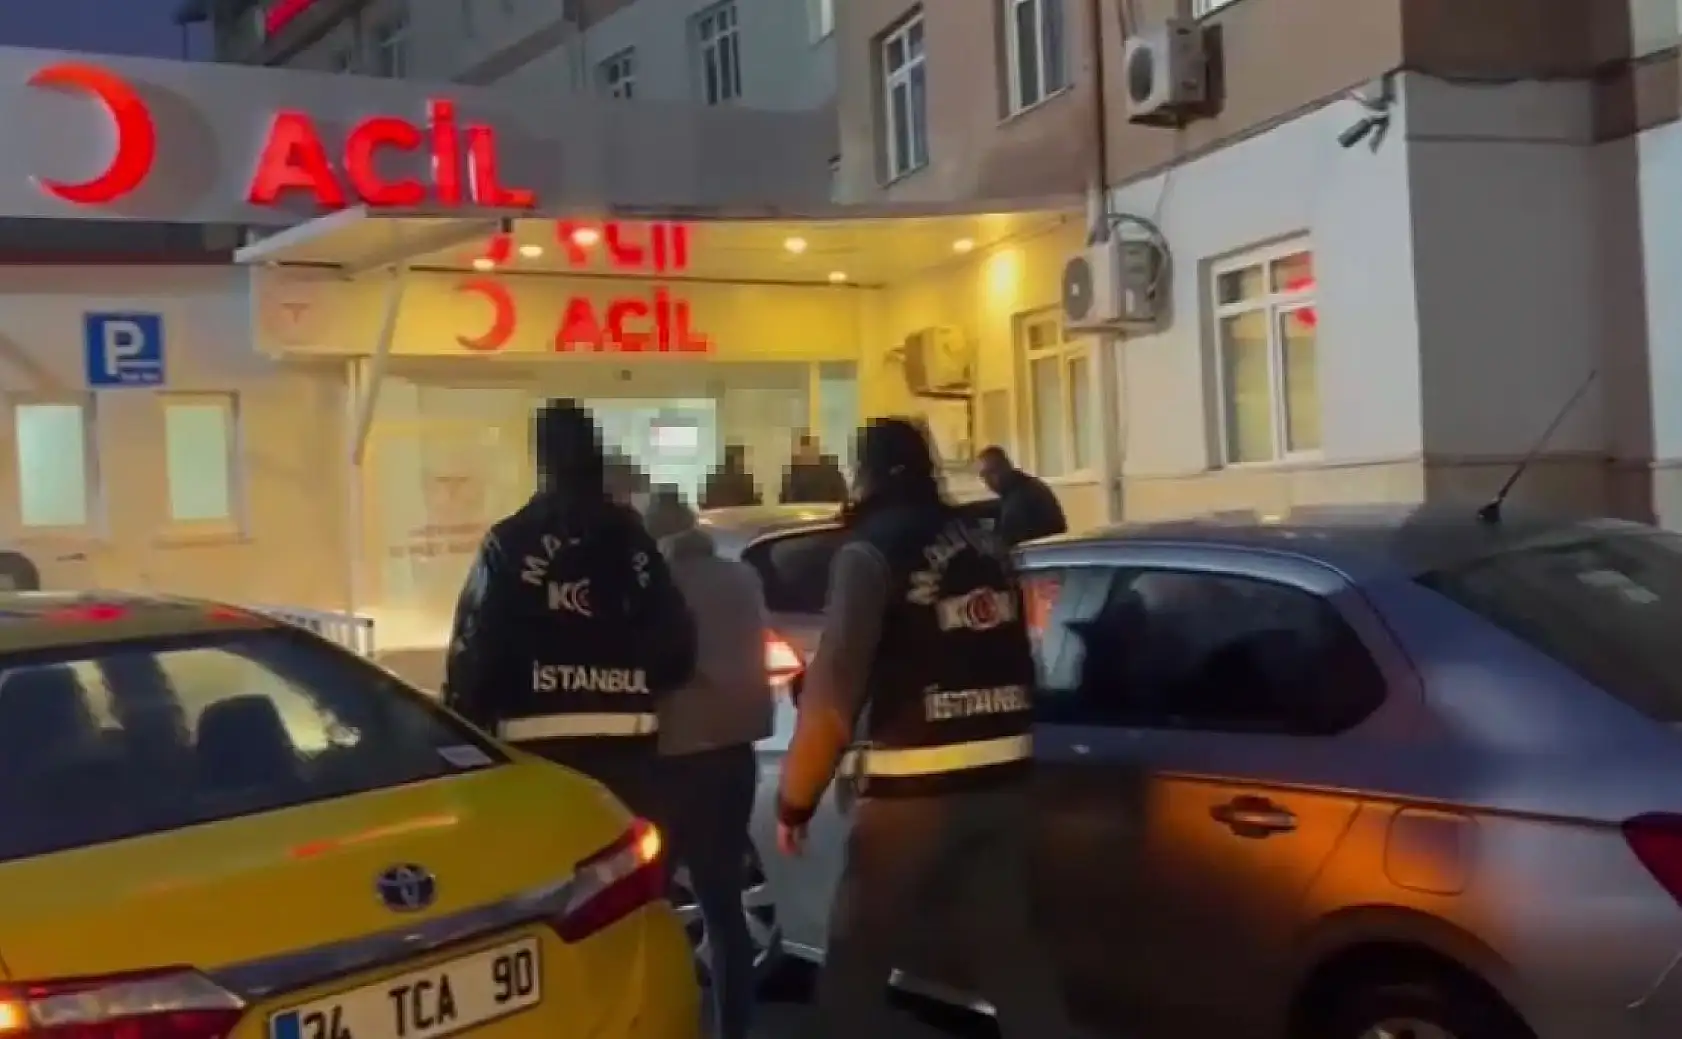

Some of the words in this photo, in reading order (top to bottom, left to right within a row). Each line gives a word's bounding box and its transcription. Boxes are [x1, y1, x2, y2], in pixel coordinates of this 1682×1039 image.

[248, 96, 536, 209] ACİL
[103, 320, 144, 376] P
[532, 660, 649, 694] İSTANBUL
[388, 975, 457, 1036] TCA
[492, 949, 533, 1003] 90
